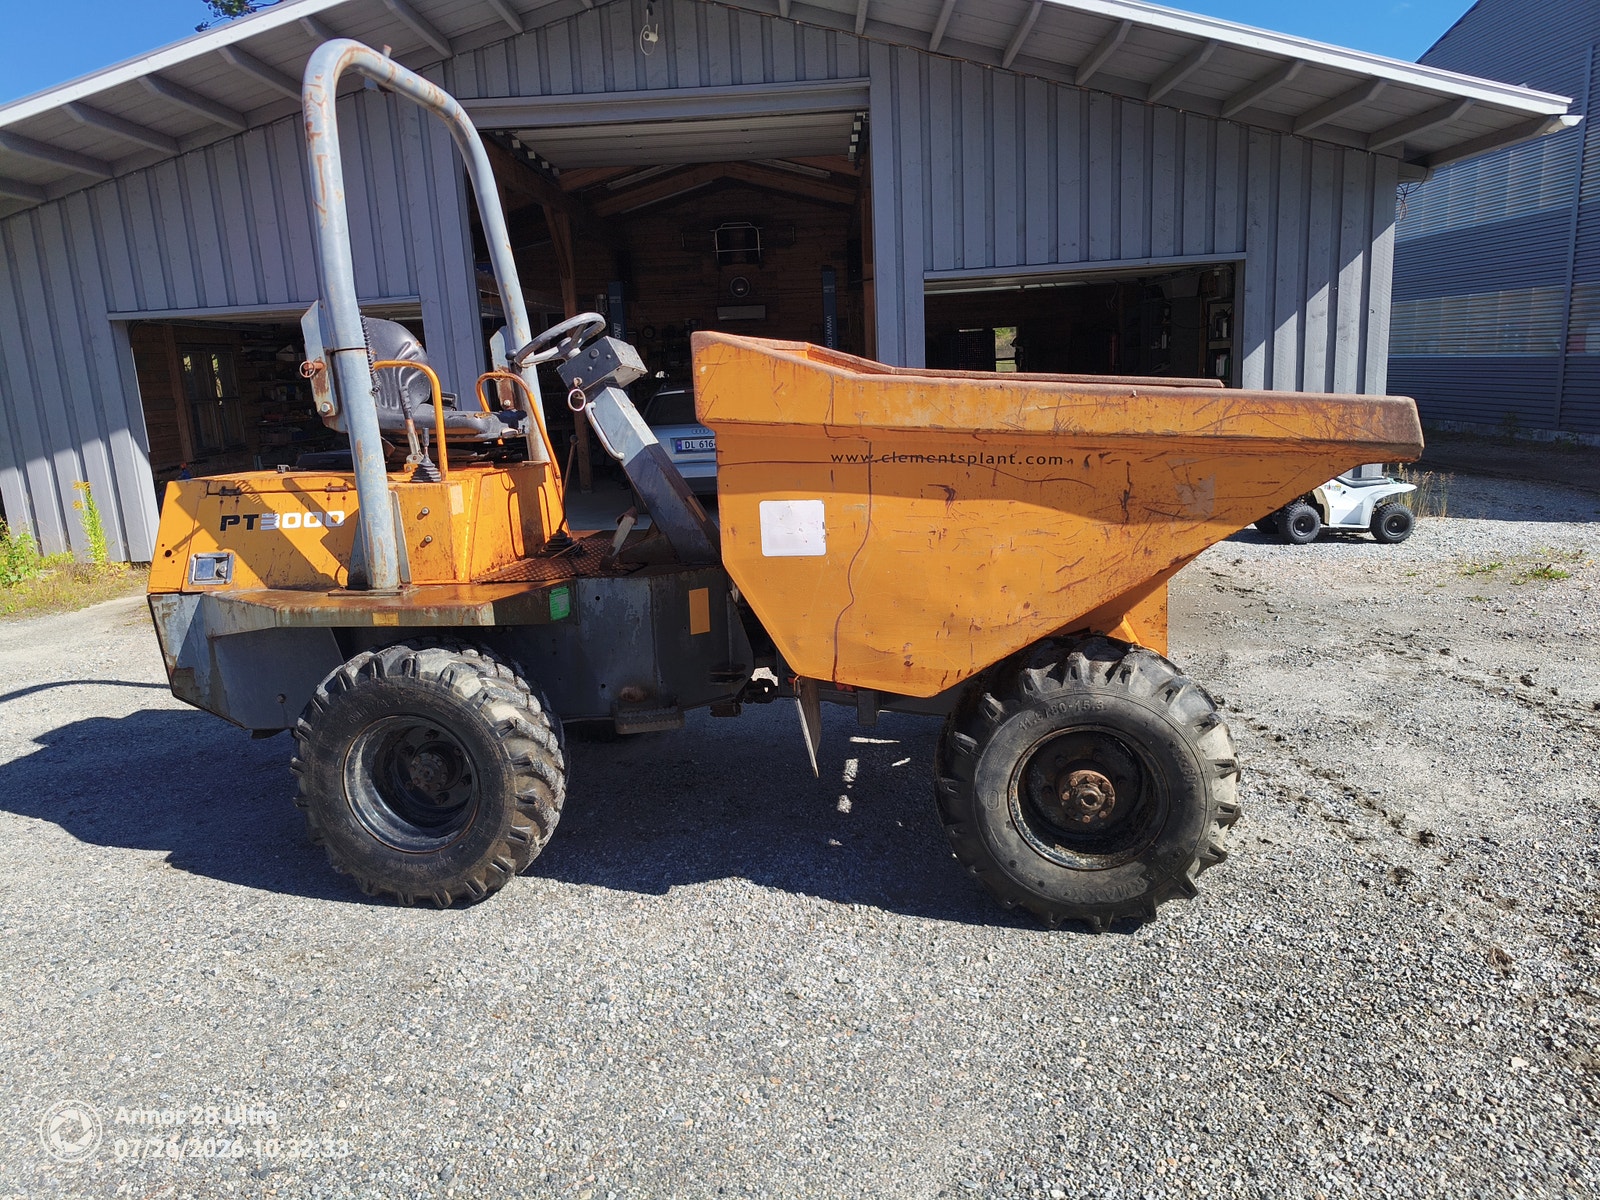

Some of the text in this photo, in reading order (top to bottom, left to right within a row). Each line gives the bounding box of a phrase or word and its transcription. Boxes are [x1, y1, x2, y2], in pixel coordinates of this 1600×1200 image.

[685, 440, 716, 449] DL 616
[831, 451, 1063, 466] www.clementsplant.com
[220, 510, 345, 531] PT3000
